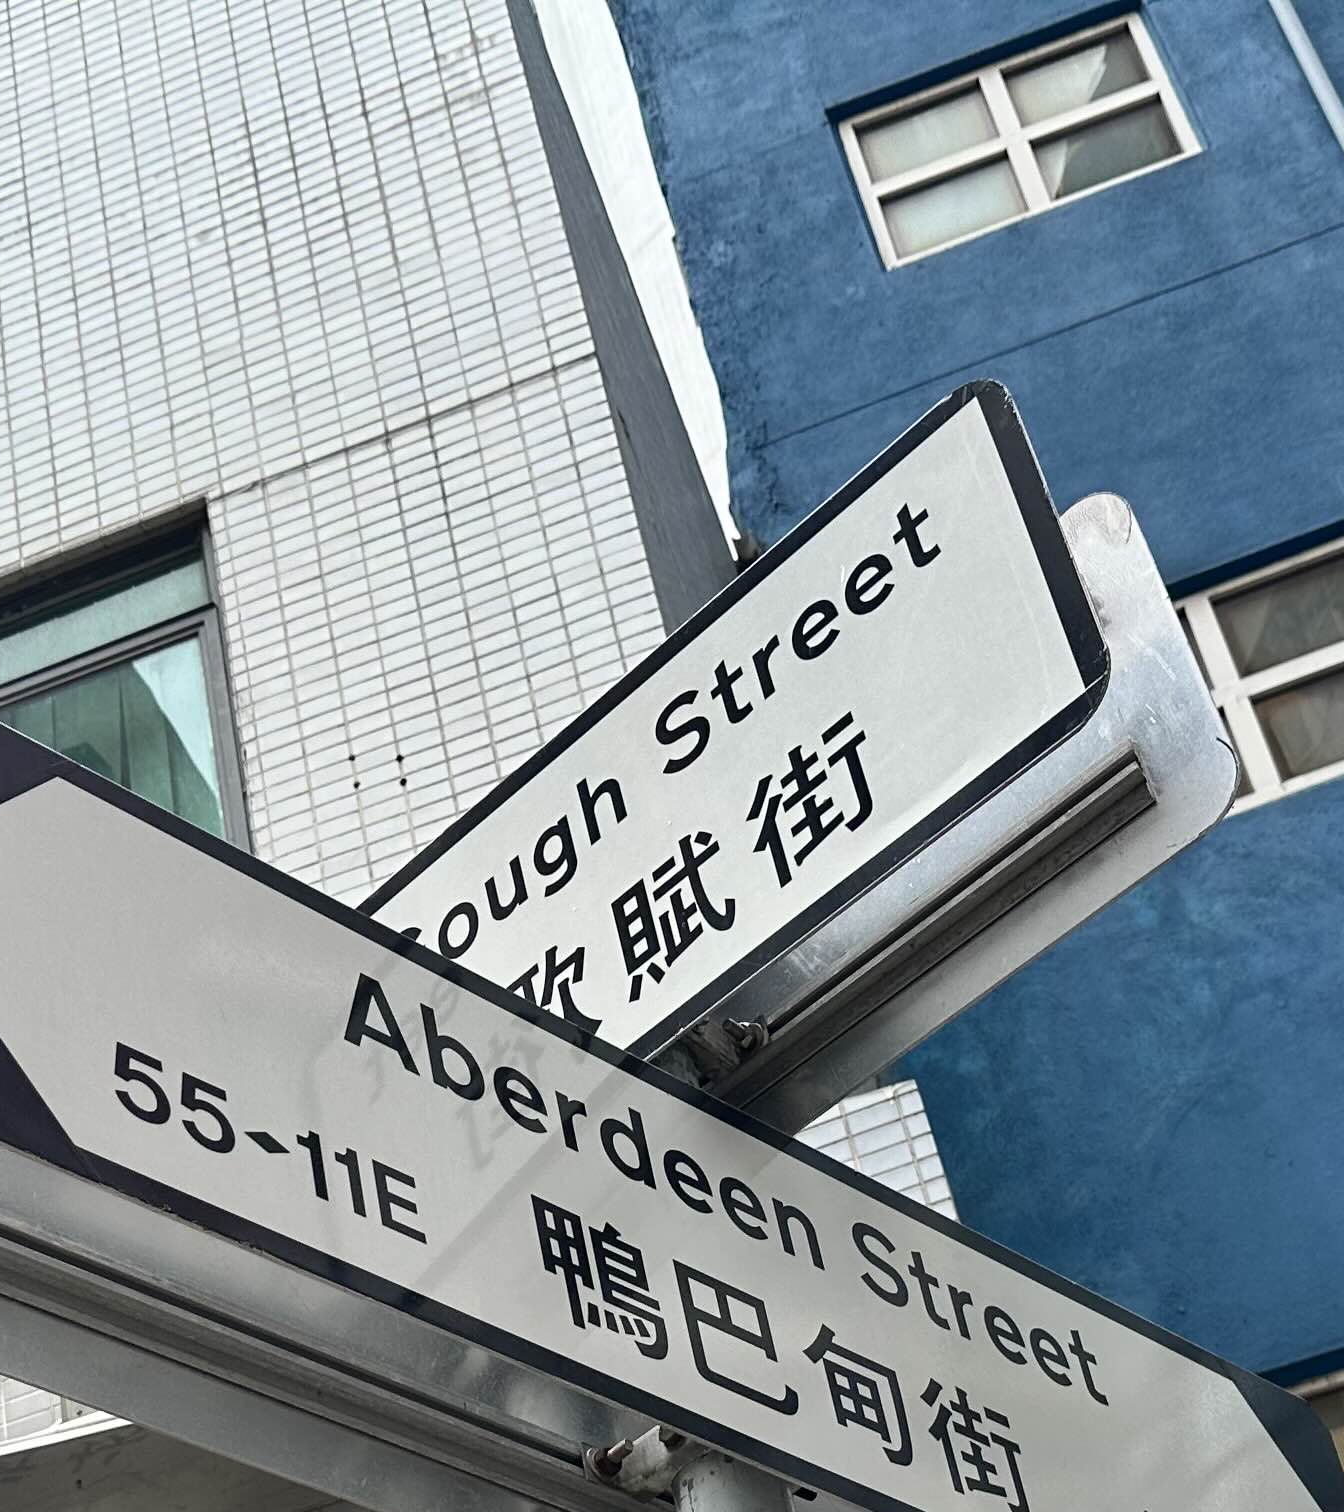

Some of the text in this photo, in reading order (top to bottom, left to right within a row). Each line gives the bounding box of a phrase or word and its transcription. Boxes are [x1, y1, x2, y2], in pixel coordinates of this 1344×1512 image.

[399, 502, 943, 960] ough Street
[346, 972, 1110, 1407] Aberdeen Street
